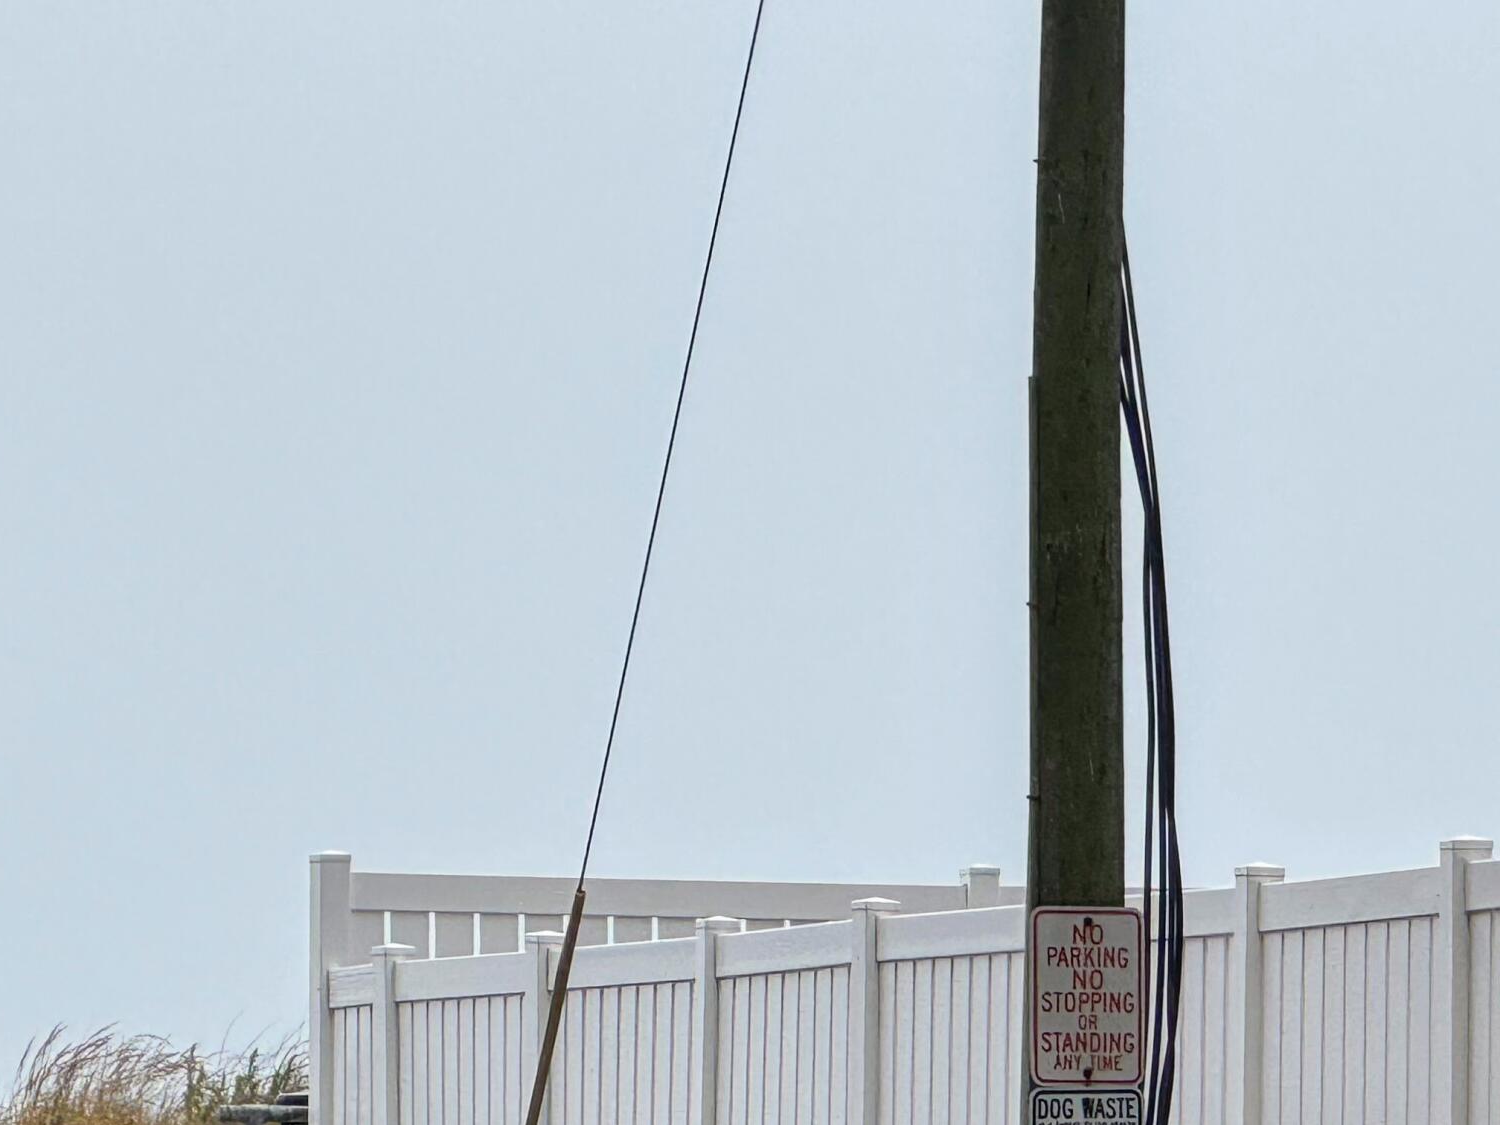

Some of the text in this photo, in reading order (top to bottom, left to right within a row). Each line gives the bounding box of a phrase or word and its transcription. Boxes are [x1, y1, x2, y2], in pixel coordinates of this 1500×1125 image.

[1072, 923, 1104, 946] NO
[1047, 946, 1129, 968] PARKING
[1072, 969, 1104, 990] NO
[1041, 992, 1135, 1014] STOPPING
[1078, 1014, 1098, 1030] OR
[1041, 1032, 1135, 1054] STANDING
[1053, 1054, 1124, 1071] ANY TIME
[1037, 1096, 1138, 1120] DOG WASTE
